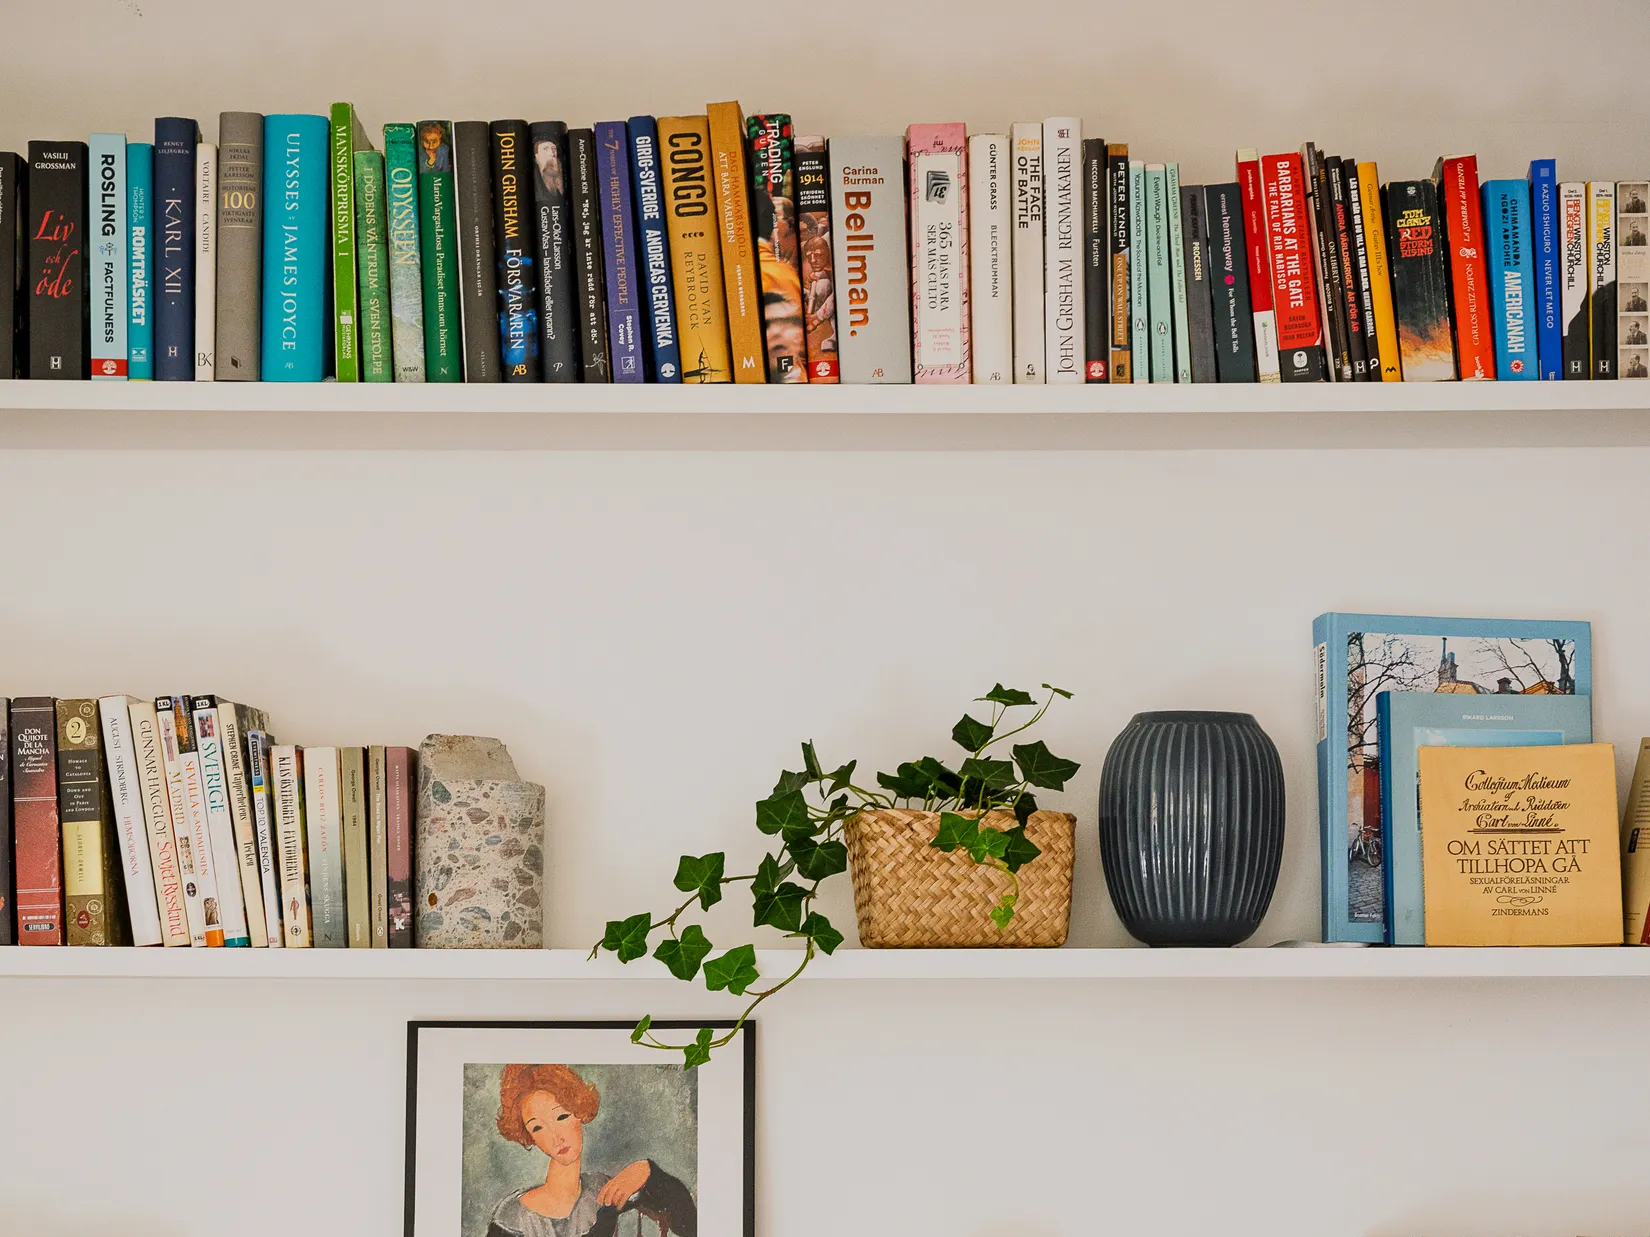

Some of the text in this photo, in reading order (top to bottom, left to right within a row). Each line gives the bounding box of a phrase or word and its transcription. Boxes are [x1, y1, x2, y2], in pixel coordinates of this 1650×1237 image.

[579, 139, 587, 180] Ann-Christine
[668, 132, 708, 218] CONGO
[719, 152, 728, 168] ATT
[729, 151, 738, 174] DAG
[758, 130, 769, 177] GUIDEN
[766, 120, 783, 183] TRADING
[799, 175, 824, 184] 1914
[843, 166, 878, 175] Carina
[843, 177, 884, 185] Burman
[989, 144, 998, 180] GÜNTER
[223, 192, 255, 209] 100
[336, 125, 350, 243] MANSKÖRPRISMA
[1018, 157, 1028, 228] OF BATTLE
[1030, 157, 1040, 221] THE FACE
[165, 199, 182, 293] KARL XII
[280, 133, 300, 350] ULYSSES JAMES JOYCE
[391, 168, 415, 265] ODYSSEEN
[496, 132, 524, 349] JOHN GRISHAM FÖRSVARAREN
[552, 206, 562, 270] Lars-Olof Larsson
[610, 177, 628, 304] HIGHLY EFFECTIVE PEOPLE
[635, 136, 673, 348] GIRIG-SVERIGE ANDREAS CERVENKA
[1118, 207, 1126, 248] LYNCH
[1221, 216, 1233, 271] hemingway
[1268, 182, 1285, 289] THE FALL OF RJR NABISCO
[1276, 161, 1304, 308] BARBARIANS AT THE GATE
[1336, 203, 1346, 231] ANDRA
[1511, 199, 1520, 266] CHIMAMANDA
[1543, 213, 1551, 253] ISHIGURO
[1566, 199, 1575, 290] LILJEGREN CHURCHILL
[1573, 199, 1582, 265] BENGT WINSTON
[1596, 199, 1604, 242] LILJEGREN
[1602, 199, 1611, 265] BENGT WINSTON
[101, 154, 116, 343] ROSLING FACTFULNESS
[132, 226, 148, 326] ROMTRÄSKET
[364, 176, 382, 373] DÖDENS VÄNTRUM SVEN STOLPE
[844, 191, 874, 337] Bellman.
[928, 225, 937, 310] SER CULTO
[939, 222, 952, 311] 365 PARA
[990, 225, 998, 298] BLECKTRUMMAN
[1057, 147, 1077, 374] JOHN GRISHAM REGNMAKAREN
[1092, 239, 1100, 266] Fursten
[1193, 242, 1202, 280] PROCESSEN
[1328, 241, 1339, 284] ON LIBERTY
[1502, 228, 1510, 267] ADICHIE
[1544, 260, 1552, 286] NEVER
[437, 253, 448, 356] Paradiset finns om hörnet
[543, 258, 554, 311] landsfader eller
[683, 251, 699, 330] REYBROUCK
[697, 254, 712, 325] DAVID VAN
[1504, 271, 1525, 353] AMERICANAH
[1546, 302, 1553, 314] ME
[618, 324, 626, 345] Covey
[625, 316, 633, 340] Stephen
[1546, 316, 1553, 328] GO
[110, 717, 128, 805] AUGUST STRINDBERG
[226, 724, 240, 770] STEPHEN CRANE
[279, 756, 291, 778] KLAS
[140, 720, 166, 839] GUNNAR HÄGGLÖF
[169, 771, 185, 824] MADRID
[184, 760, 199, 808] SEVILLA
[202, 742, 225, 813] SVERIGE
[259, 829, 270, 873] VALENCIA
[1448, 838, 1590, 855] OM SÄTTET ATT
[1457, 855, 1581, 874] TILLHOPA GÅ
[1470, 876, 1570, 884] SEXUALFÖRELÄSNINGAR
[1492, 908, 1549, 916] ZINDERMANS
